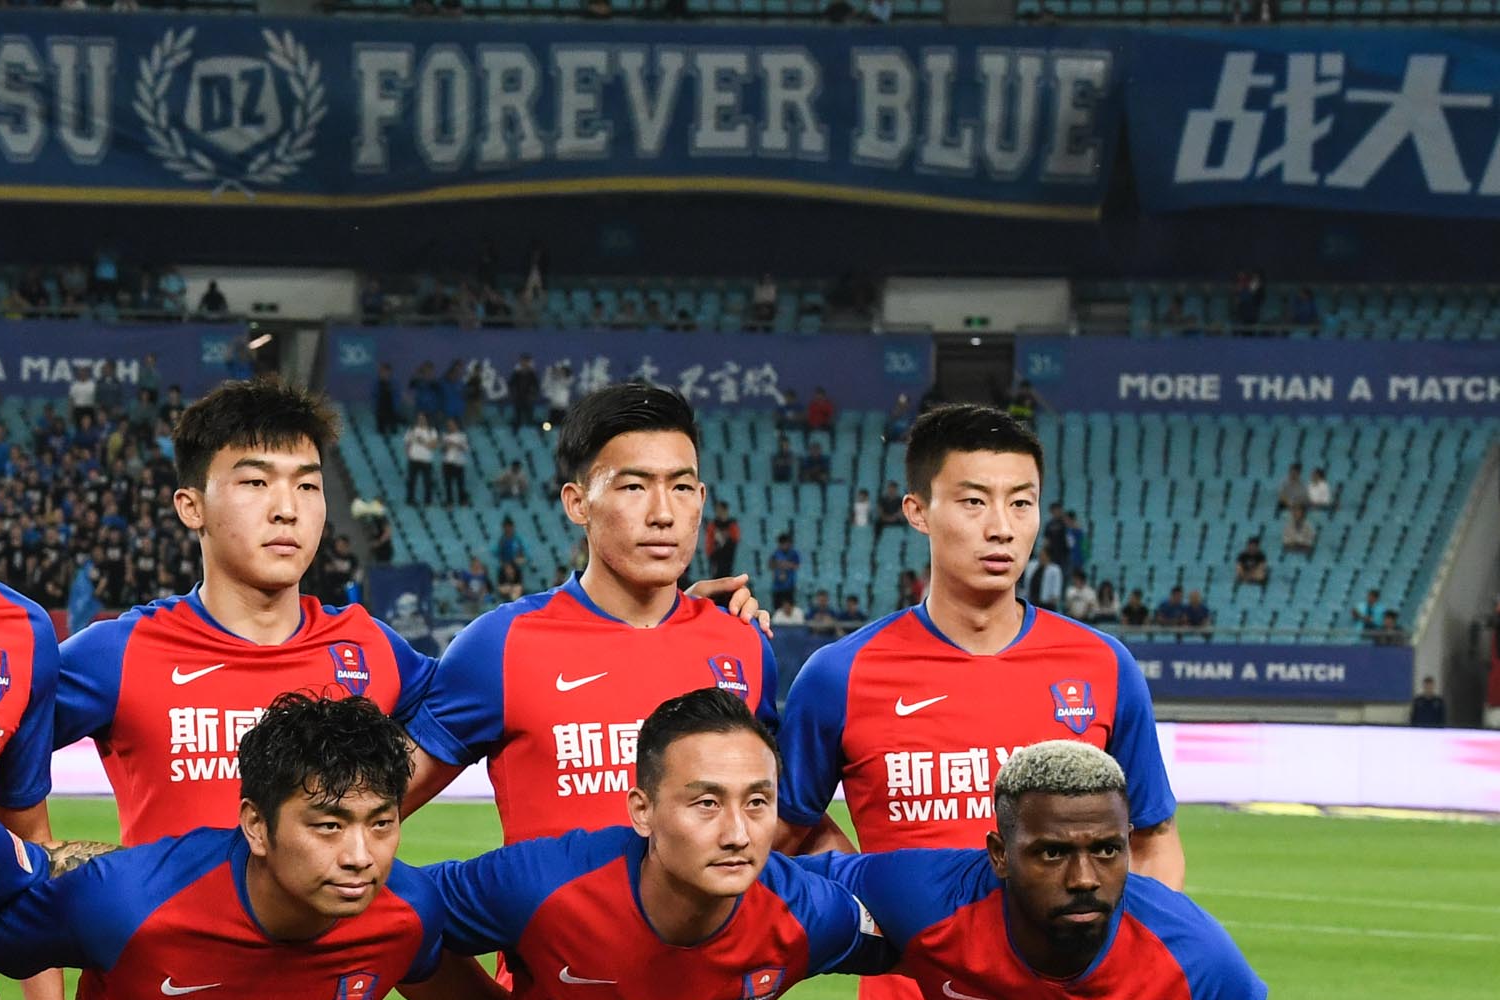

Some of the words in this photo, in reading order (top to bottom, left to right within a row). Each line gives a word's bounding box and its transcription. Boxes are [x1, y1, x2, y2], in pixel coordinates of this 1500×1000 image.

[353, 43, 830, 174] FOREVER
[851, 46, 1112, 184] BLUE
[1174, 52, 1500, 194] 战大
[1118, 373, 1221, 401] MORE
[1237, 375, 1335, 401] THAN
[1349, 375, 1374, 401] A
[1171, 661, 1234, 680] THAN
[1241, 663, 1259, 681] A
[1266, 663, 1347, 682] MATCH
[1057, 706, 1094, 718] DANGDAI
[168, 706, 267, 754] 斯威
[552, 718, 645, 770] 斯威
[170, 757, 242, 782] SWM
[557, 769, 629, 797] SWM
[884, 746, 1024, 797] 斯威
[888, 799, 959, 822] SWM
